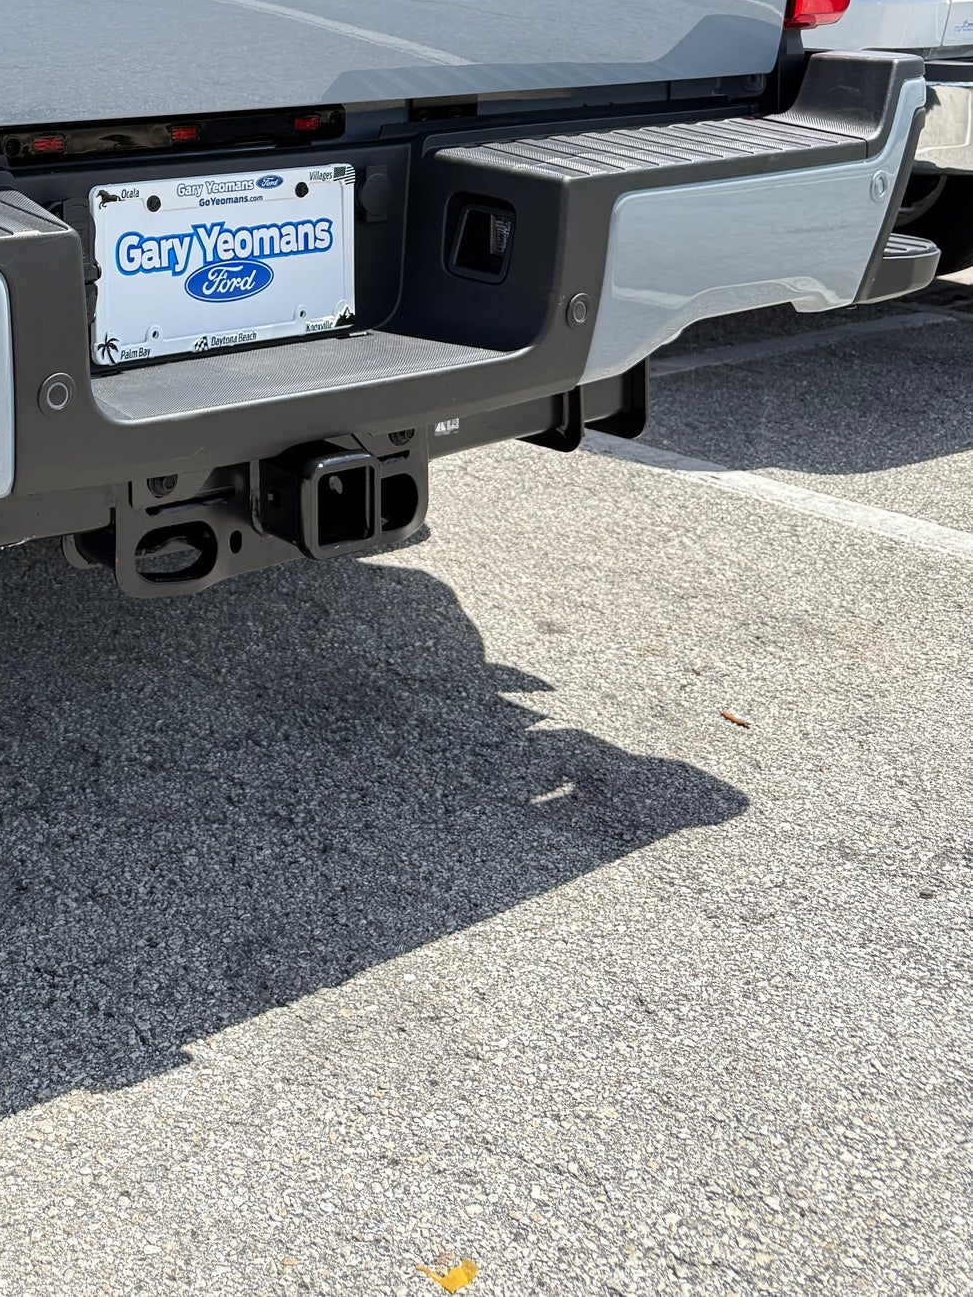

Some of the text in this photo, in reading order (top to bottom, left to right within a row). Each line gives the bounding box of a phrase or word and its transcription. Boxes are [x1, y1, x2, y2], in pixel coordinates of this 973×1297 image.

[261, 177, 279, 188] Ford
[309, 171, 333, 182] Villages
[121, 188, 140, 200] Ocala
[177, 179, 254, 197] Gary Yeomans
[199, 194, 264, 207] GoYeomans.com
[117, 218, 332, 275] Gary Yeomans
[202, 265, 256, 296] Ford
[305, 320, 333, 332] Knoxville
[211, 331, 257, 347] Daytona Beach
[120, 347, 151, 360] Palm Bay
